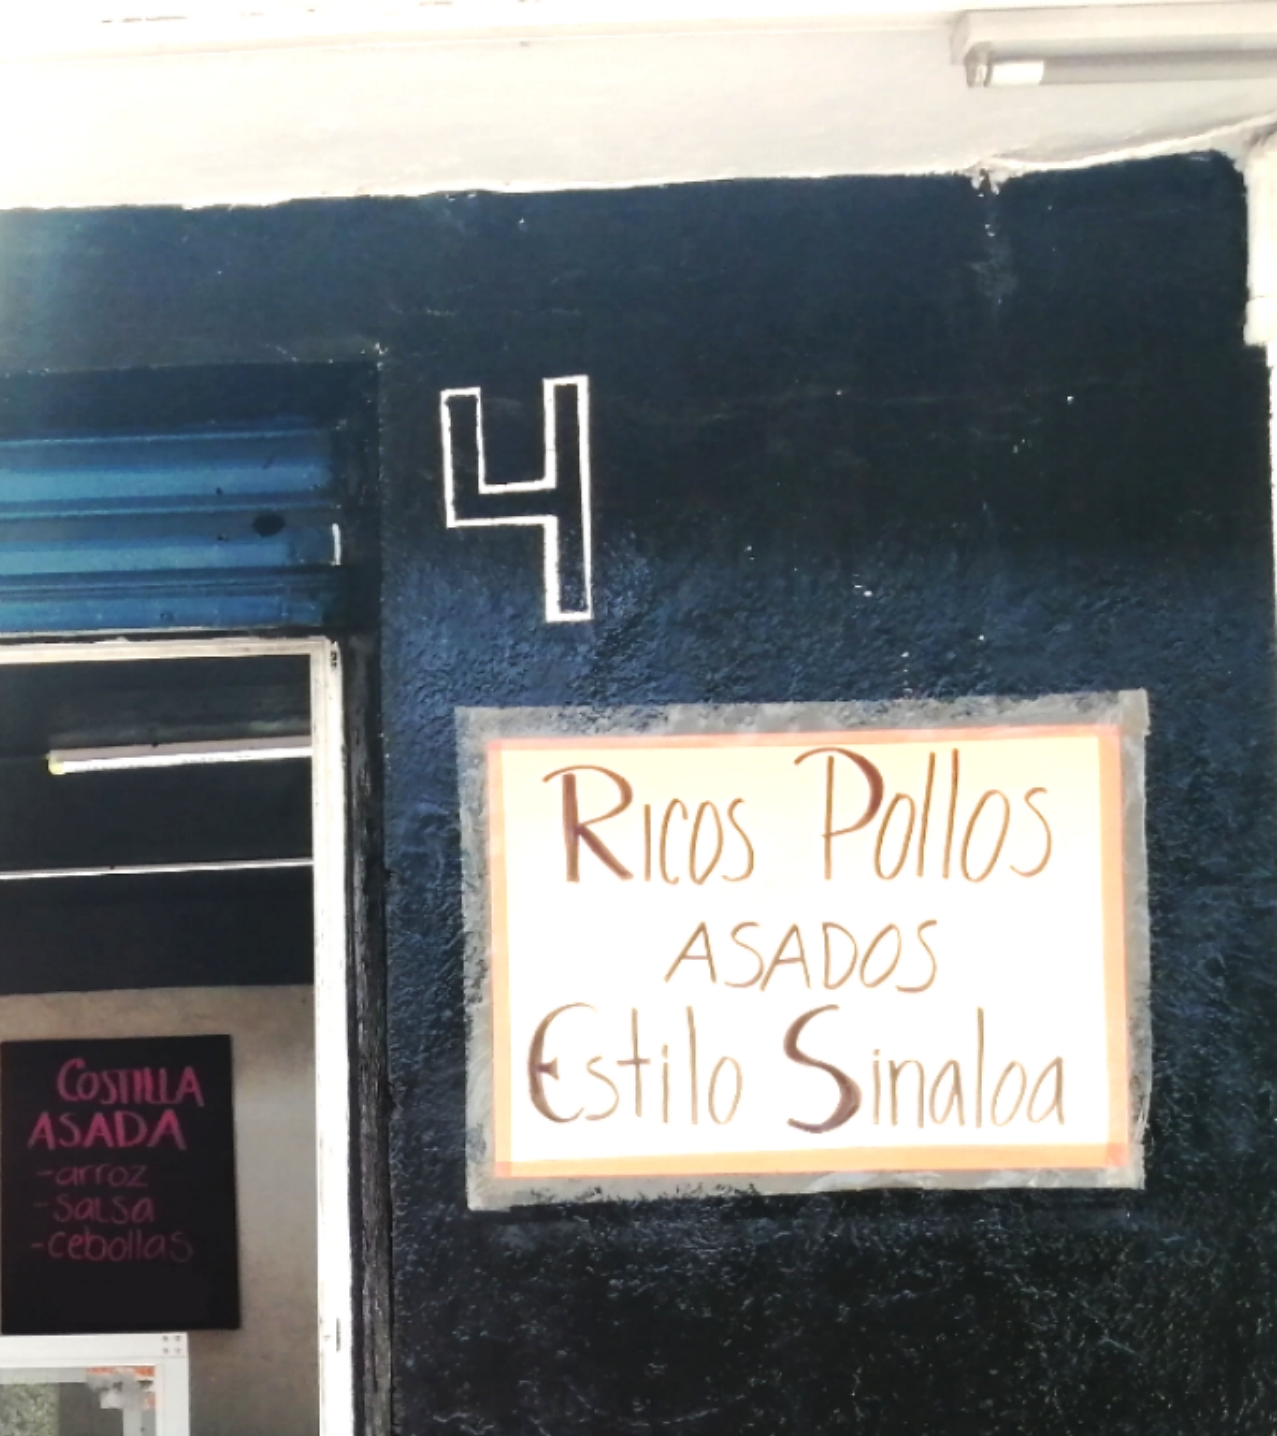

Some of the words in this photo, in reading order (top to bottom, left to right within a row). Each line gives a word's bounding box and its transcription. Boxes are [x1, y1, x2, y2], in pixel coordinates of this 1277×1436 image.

[440, 373, 593, 624] 4
[794, 745, 1053, 883] Pollos
[664, 918, 939, 994] ASADOS
[27, 1108, 187, 1150] ASADA
[527, 1002, 744, 1126] Estilo
[782, 1003, 1065, 1135] Sinaloa
